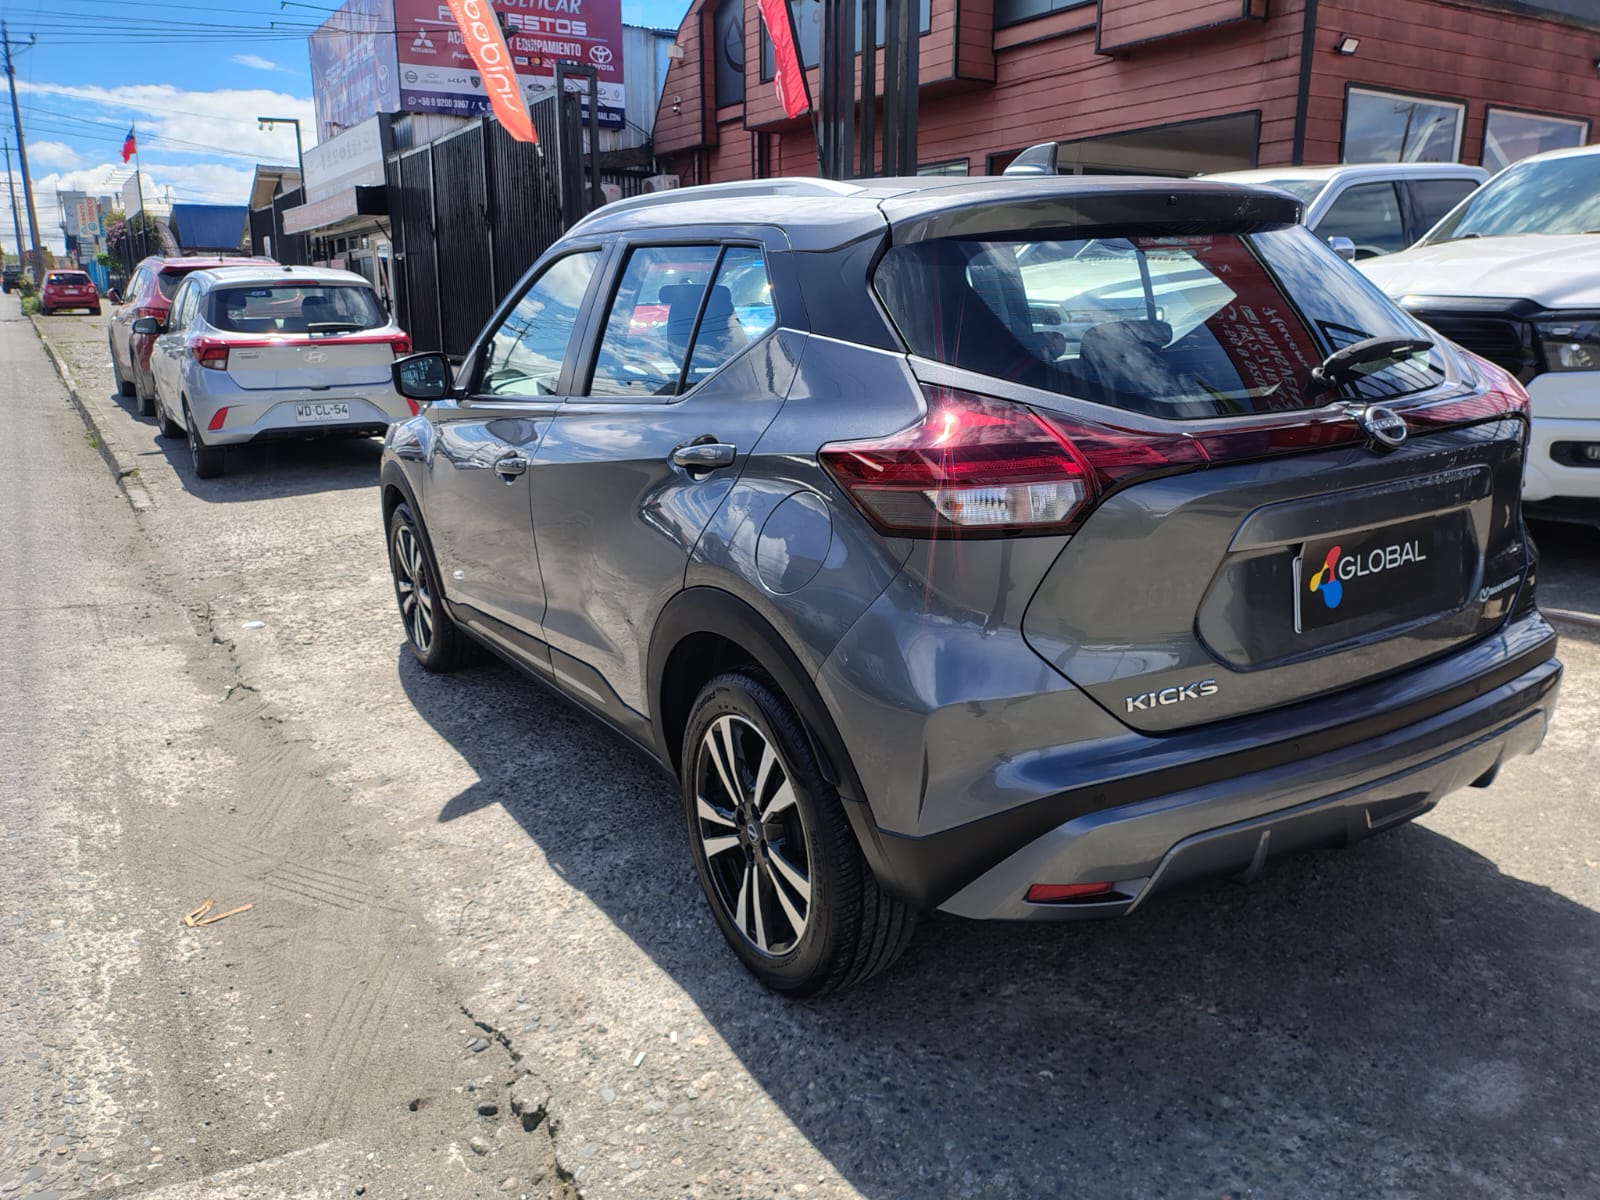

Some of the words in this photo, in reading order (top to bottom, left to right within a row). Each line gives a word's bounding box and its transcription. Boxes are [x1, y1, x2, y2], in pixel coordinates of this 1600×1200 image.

[515, 37, 582, 57] EQUIPAMIENTO
[1338, 540, 1426, 581] GLOBAL
[1125, 679, 1219, 713] KICKS
